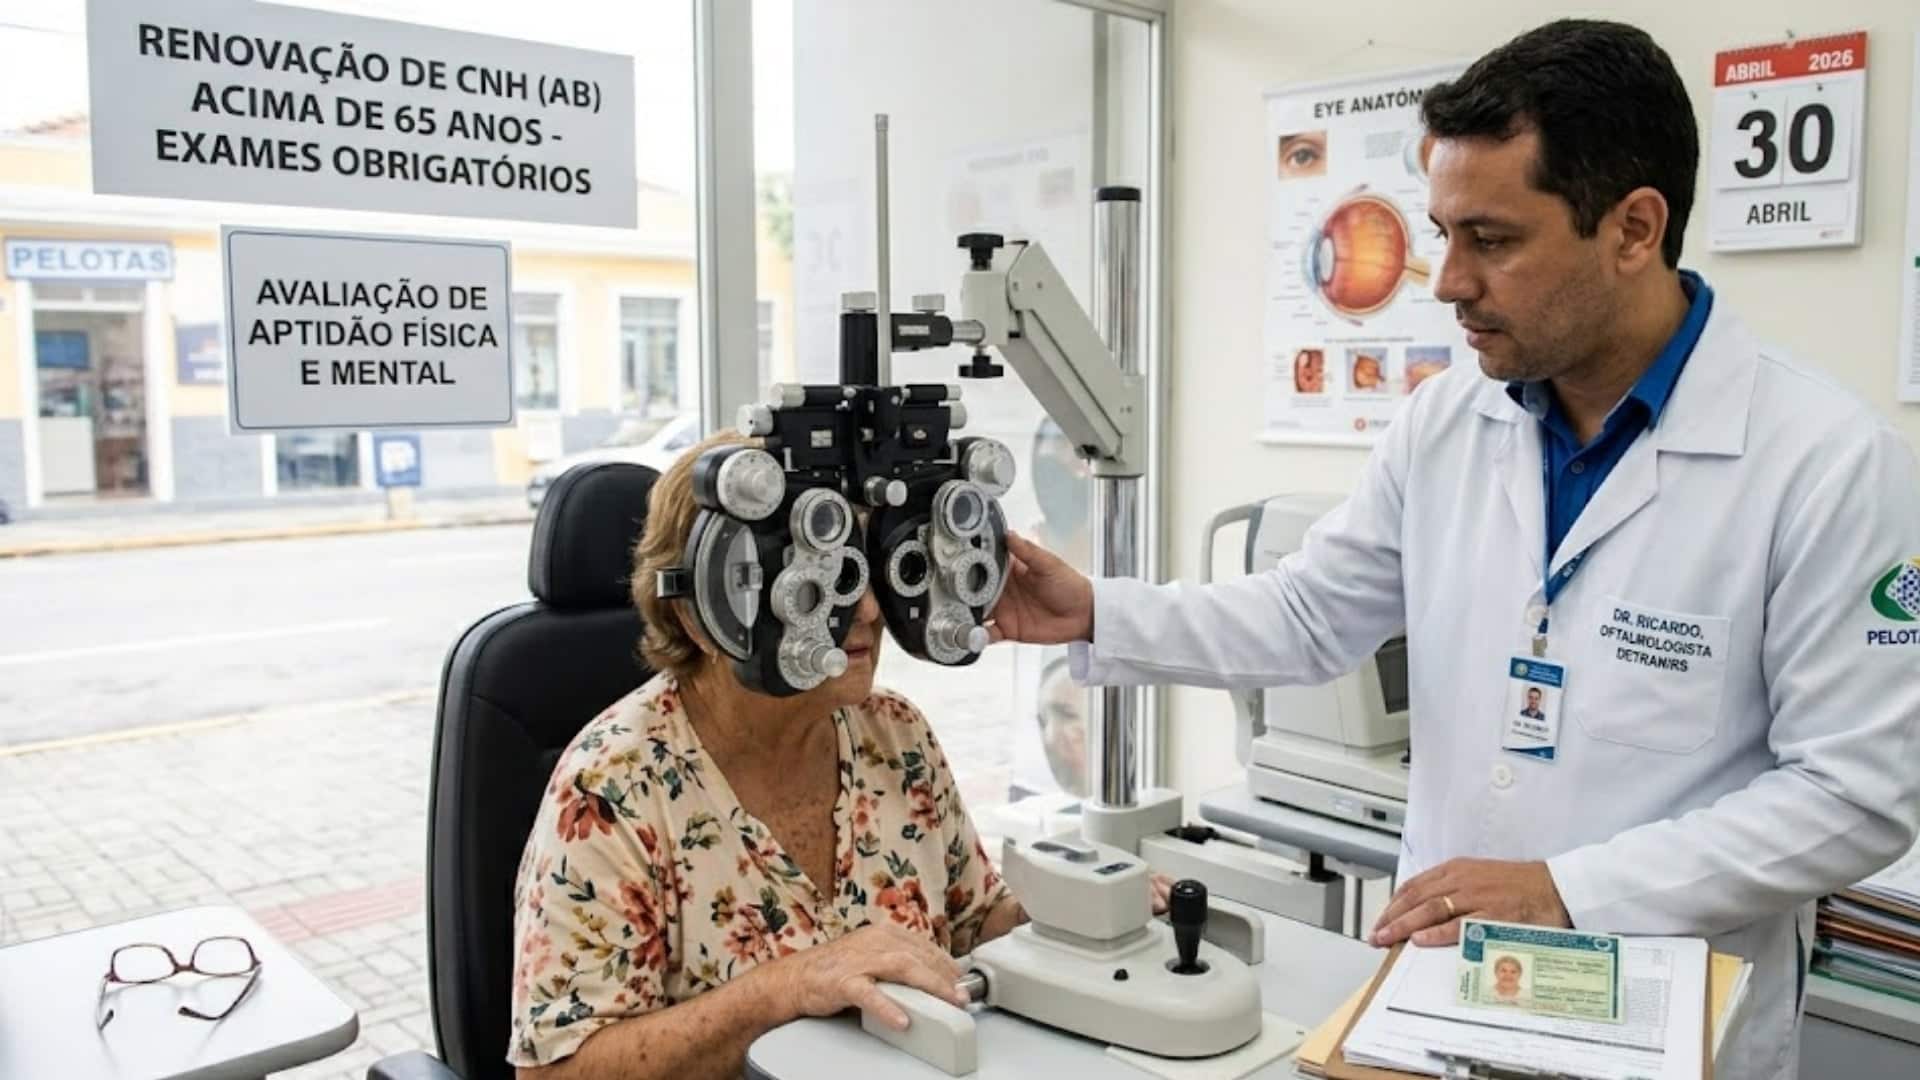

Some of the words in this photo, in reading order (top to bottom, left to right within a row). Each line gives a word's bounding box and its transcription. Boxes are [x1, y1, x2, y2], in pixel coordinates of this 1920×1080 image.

[138, 23, 390, 84] RENOVAÇÃO
[401, 57, 447, 90] DE
[456, 65, 528, 100] CNH
[538, 74, 602, 114] (AB)
[1725, 61, 1776, 82] ABRIL
[1809, 49, 1853, 71] 2026
[191, 82, 325, 126] ACIMA
[336, 96, 385, 131] DE
[394, 105, 437, 136] 65
[447, 110, 542, 146] ANOS
[1314, 100, 1346, 119] EYE
[1733, 102, 1836, 180] 30
[156, 128, 322, 173] EXAMES
[332, 145, 592, 195] OBRIGATÓRIOS
[1746, 200, 1812, 225] ABRIL
[12, 246, 168, 272] PELOTAS
[257, 278, 439, 315] AVALIAÇÃO
[449, 286, 487, 311] DE
[248, 315, 393, 347] APTIDÃO
[403, 315, 498, 348] FÍSICA
[300, 360, 321, 386] E
[331, 360, 456, 386] MENTAL
[1612, 607, 1633, 626] DR.
[1599, 624, 1713, 658] OFTALMOLOGISTA
[1866, 630, 1920, 645] PELOT
[1615, 647, 1689, 673] DETRAN/RS
